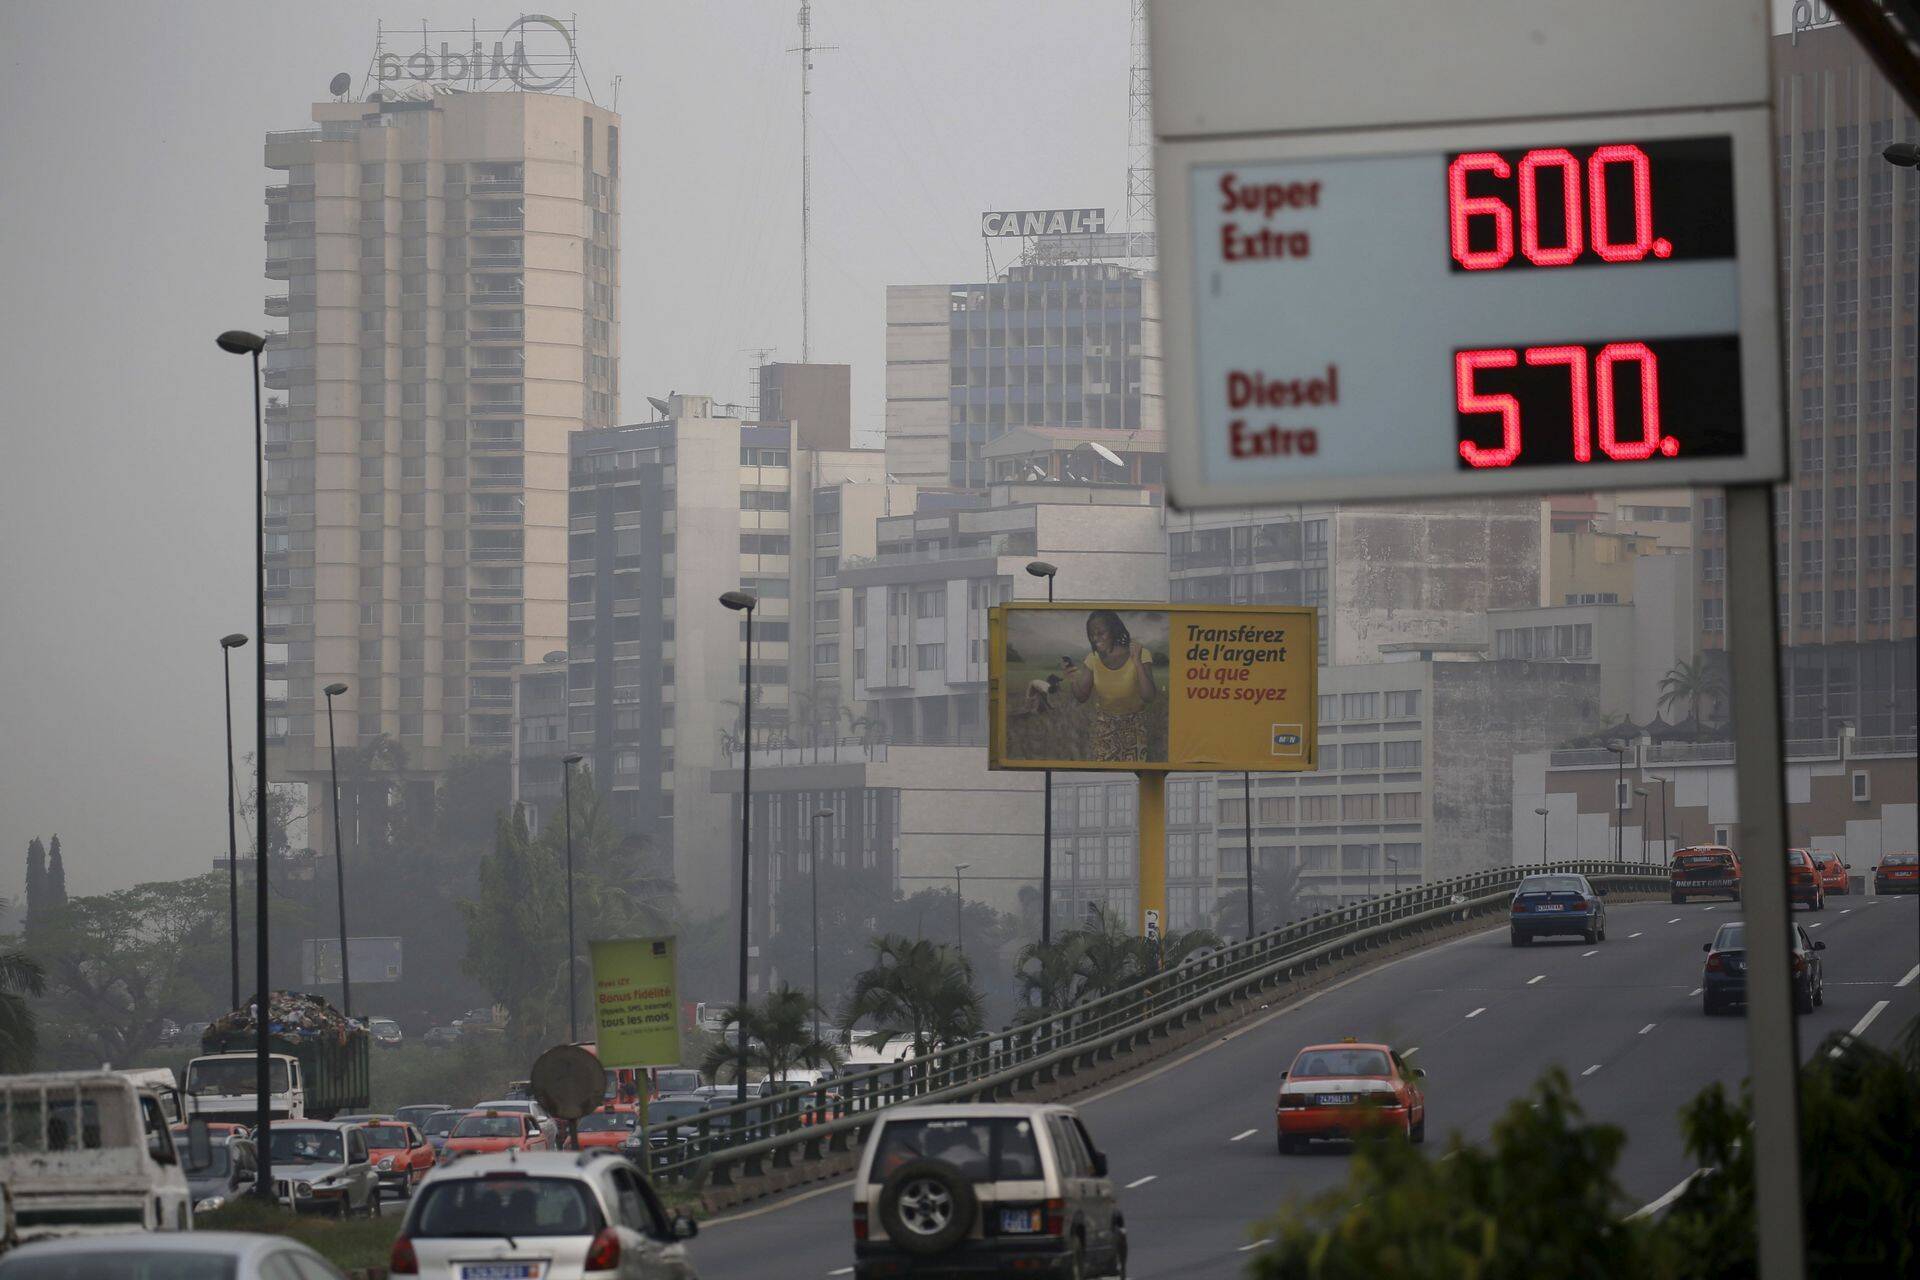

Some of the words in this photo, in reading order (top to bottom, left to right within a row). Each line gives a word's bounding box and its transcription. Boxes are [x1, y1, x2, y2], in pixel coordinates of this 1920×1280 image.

[1219, 172, 1321, 219] Super
[982, 209, 1104, 237] CANAL+
[1221, 222, 1310, 261] Extra
[1226, 361, 1339, 409] Diesel
[1229, 418, 1318, 459] Extra
[1186, 624, 1286, 643] Transférez
[1186, 644, 1209, 661] de
[1213, 643, 1287, 666] l'argent
[1186, 664, 1211, 681] où
[1214, 666, 1250, 685] que
[1186, 686, 1231, 700] vous
[1233, 687, 1287, 706] soyez
[599, 992, 632, 1004] Bonus
[601, 1016, 625, 1029] tous
[627, 1015, 642, 1025] les
[644, 1012, 670, 1023] mois
